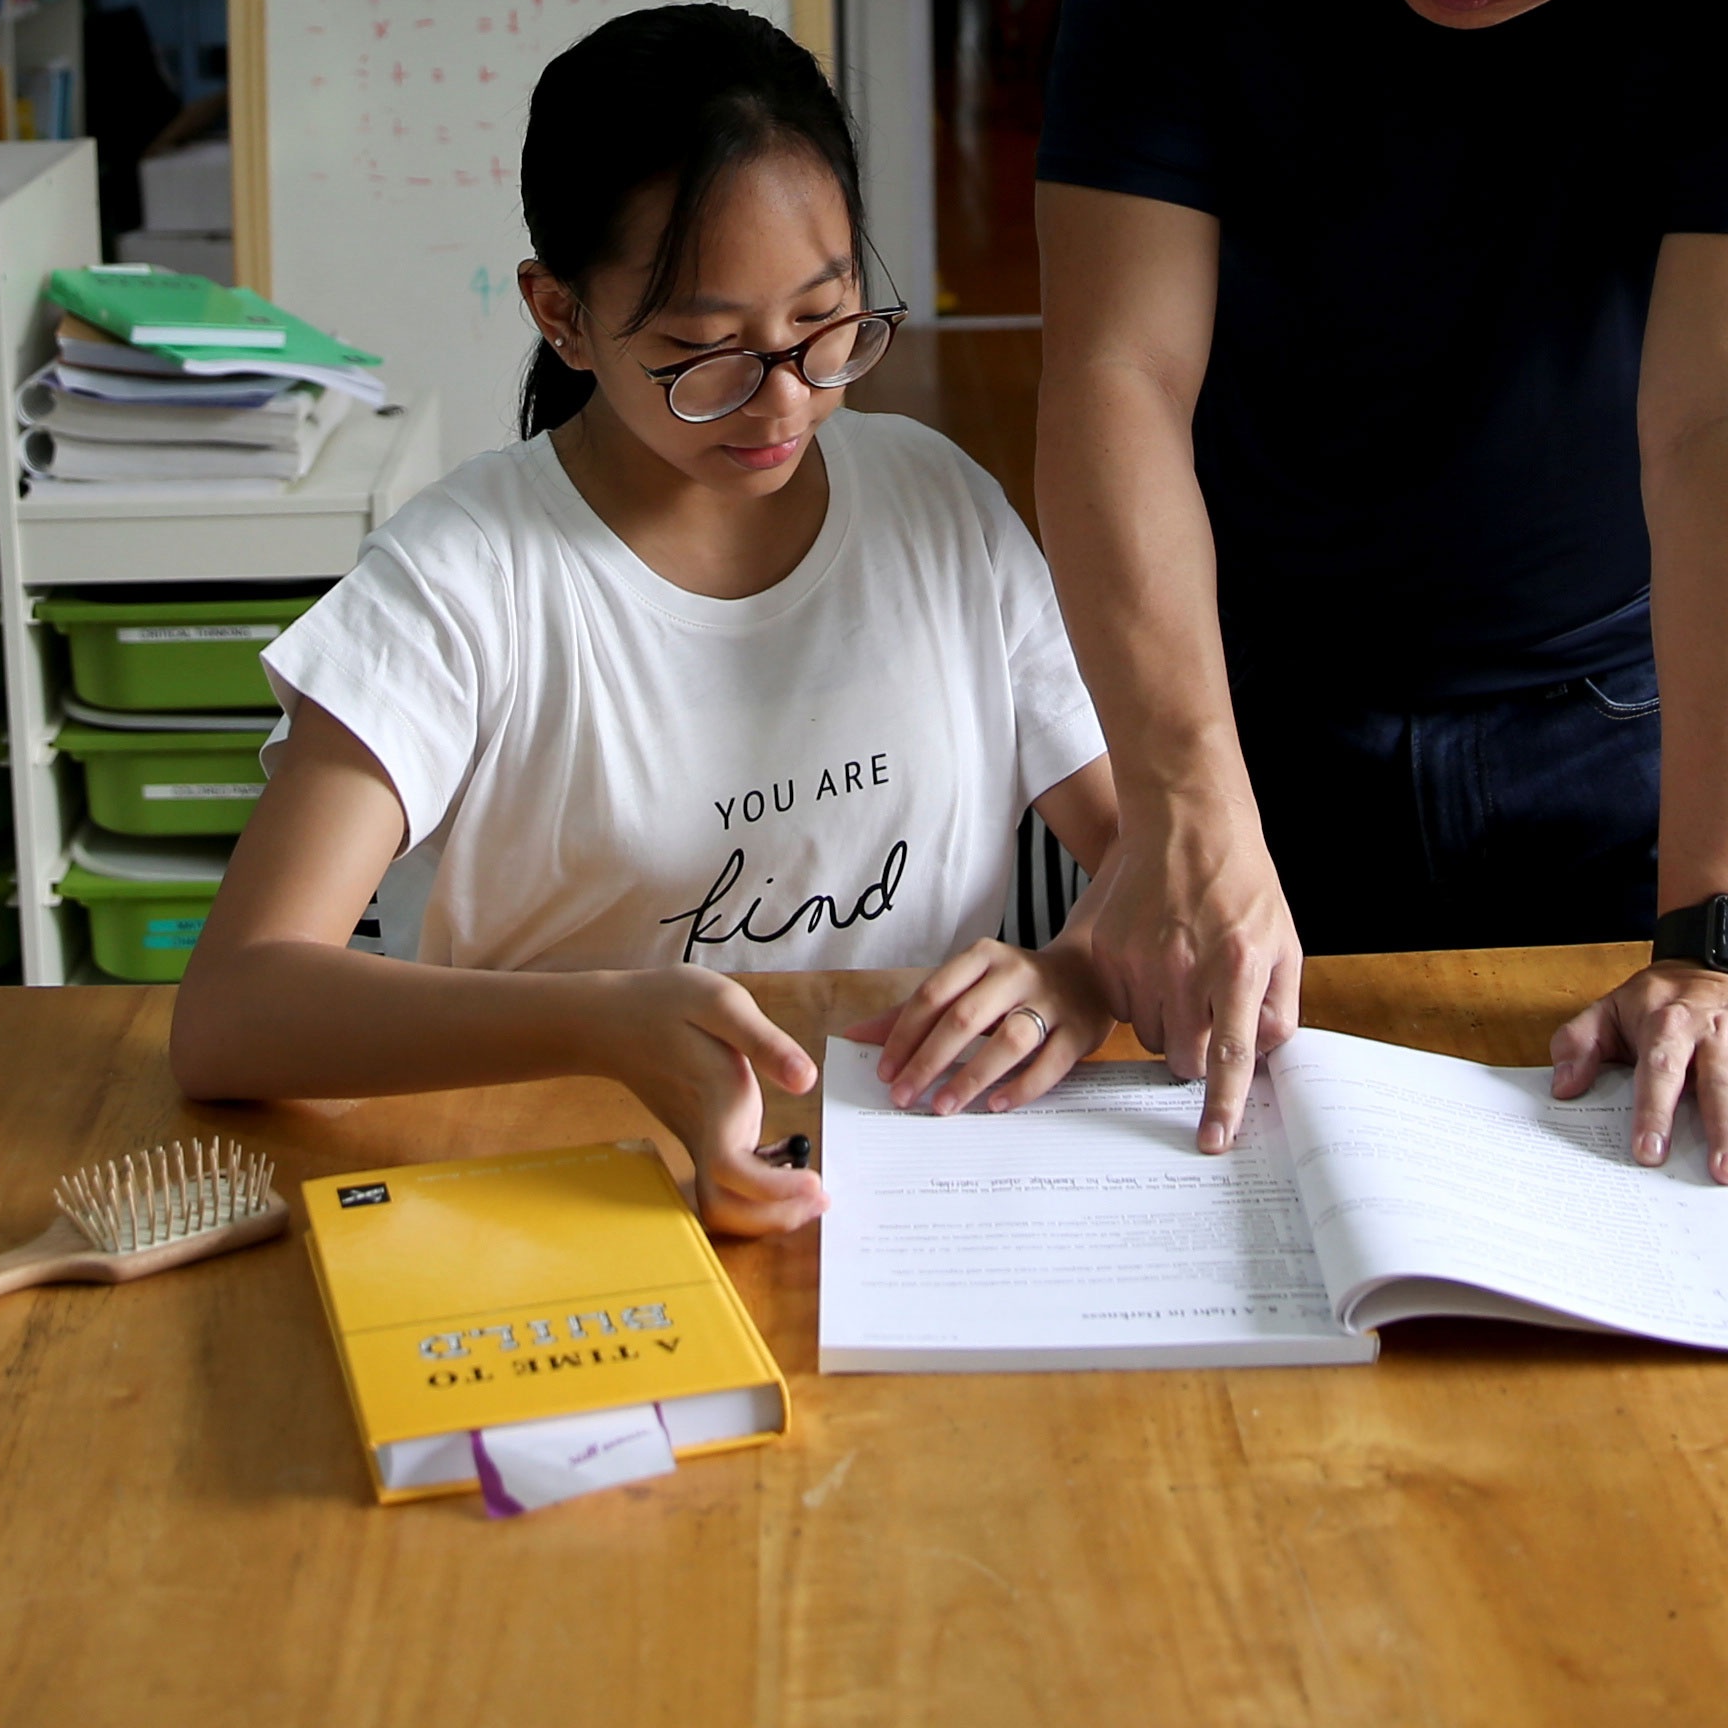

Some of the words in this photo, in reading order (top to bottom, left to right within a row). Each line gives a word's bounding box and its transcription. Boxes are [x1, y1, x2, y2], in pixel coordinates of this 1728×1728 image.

[714, 779, 798, 831] YOU
[816, 752, 891, 804] ARE
[661, 840, 909, 964] kind
[1081, 1309, 1161, 1321] Darkness
[419, 1303, 674, 1361] BUILD
[655, 1336, 680, 1355] A
[427, 1365, 494, 1390] TO
[512, 1345, 640, 1378] TIME
